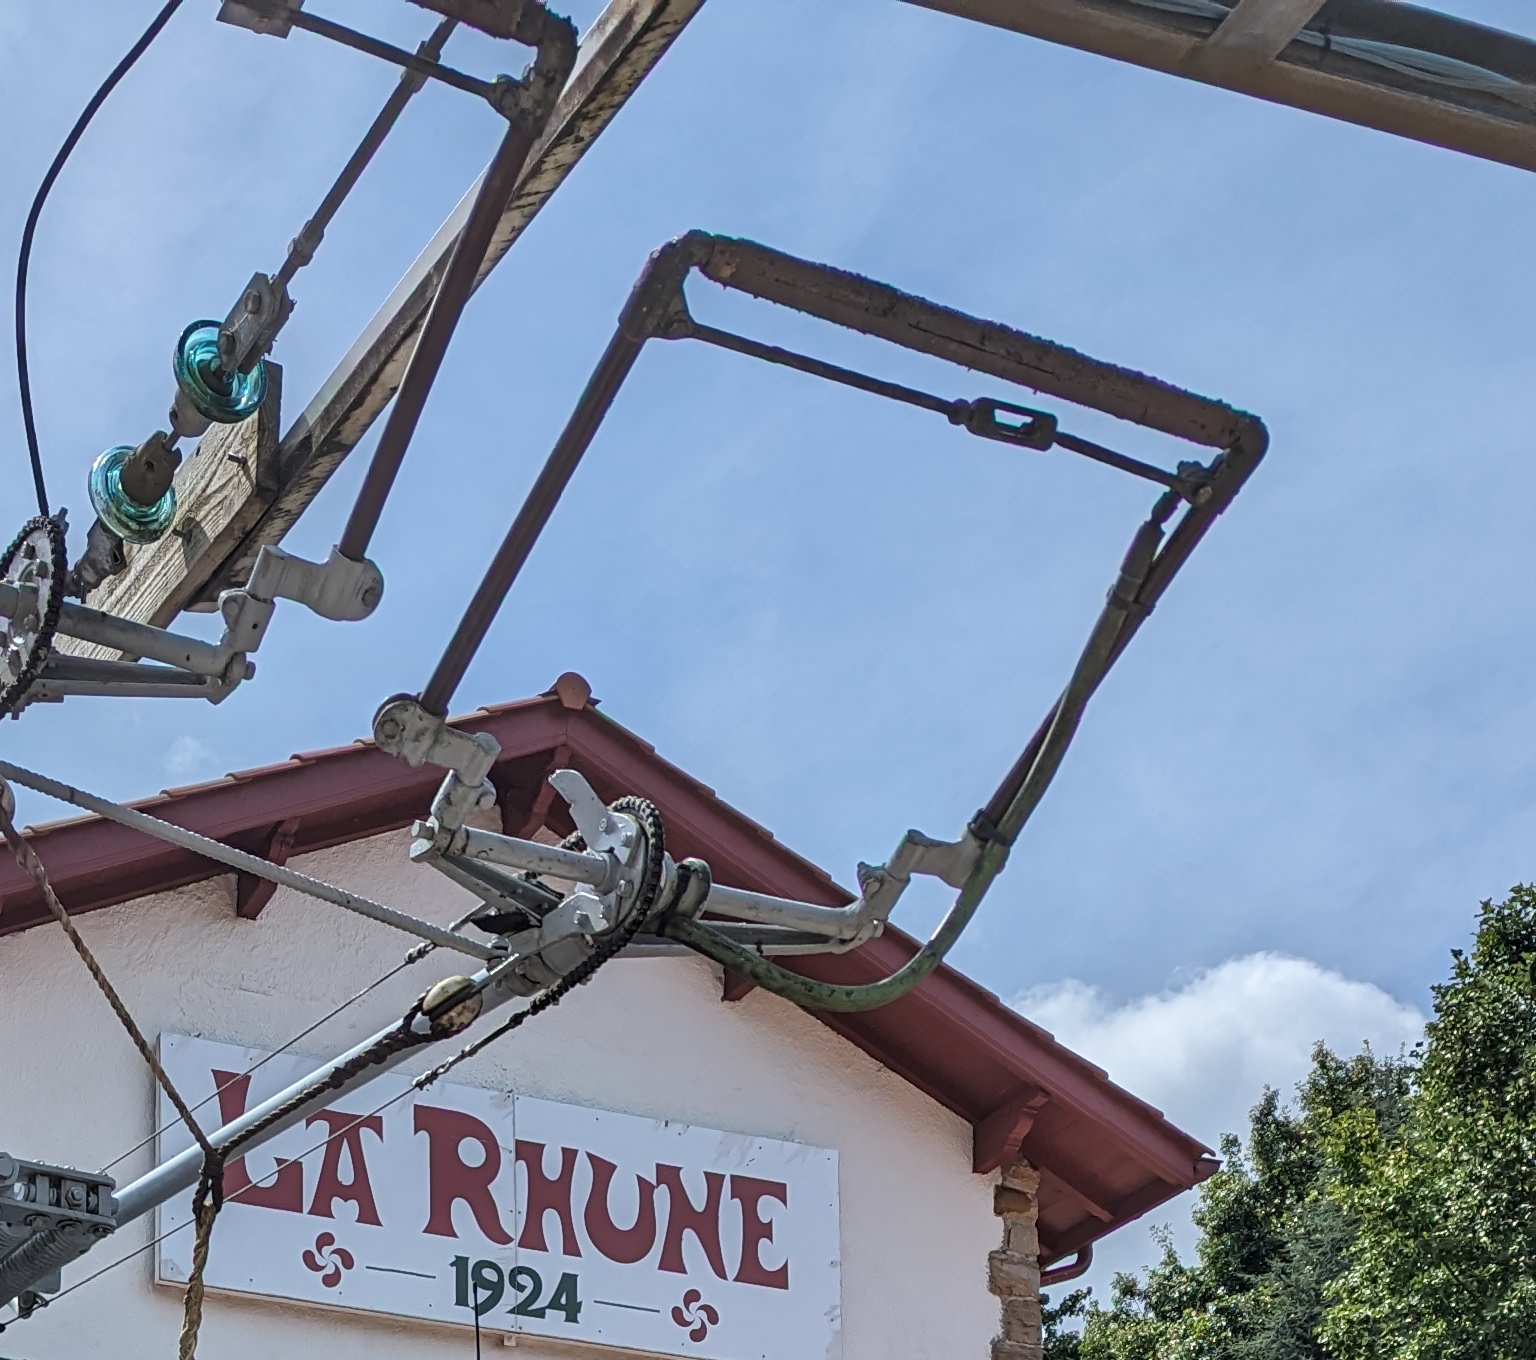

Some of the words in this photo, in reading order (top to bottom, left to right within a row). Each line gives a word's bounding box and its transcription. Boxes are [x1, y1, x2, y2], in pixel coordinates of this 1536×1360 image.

[211, 1069, 384, 1227] LA
[413, 1104, 789, 1290] RHUNE
[449, 1254, 583, 1324] 1924
